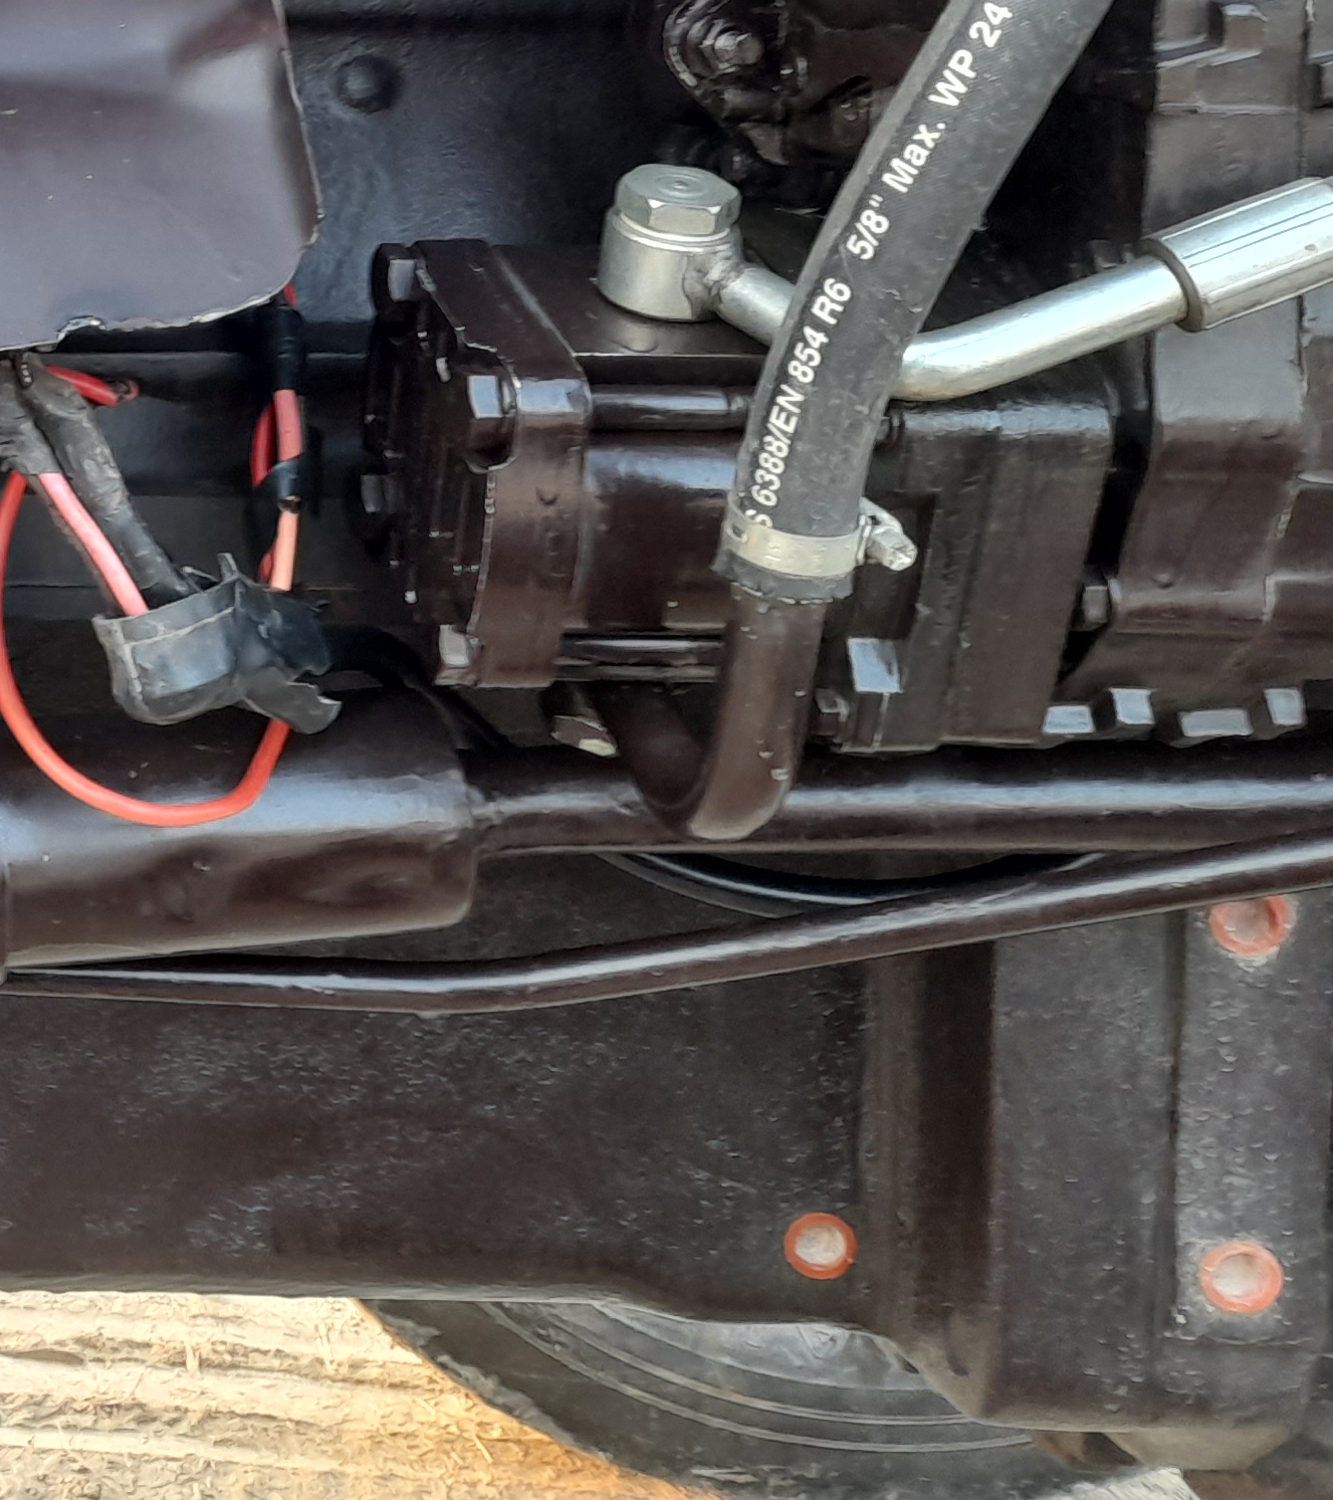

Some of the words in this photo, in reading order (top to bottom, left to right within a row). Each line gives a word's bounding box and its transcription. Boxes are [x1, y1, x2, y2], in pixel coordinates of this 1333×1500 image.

[750, 384, 805, 507] 6388/EN
[787, 325, 830, 384] 854
[810, 277, 851, 325] R6
[846, 193, 890, 260] 5/8"
[881, 123, 947, 193] Max.
[928, 49, 977, 107] WP
[969, 2, 1013, 48] 24
